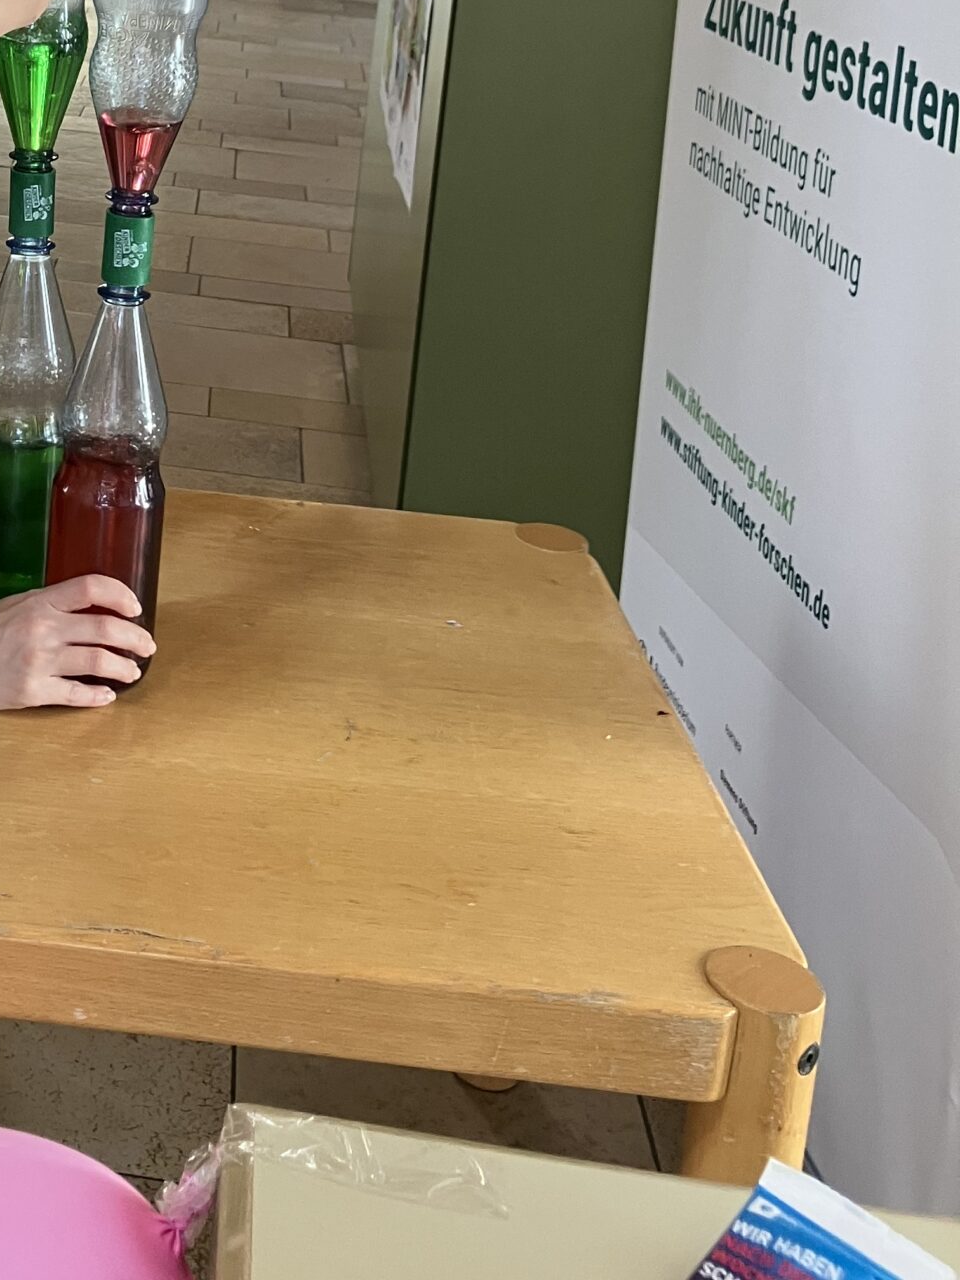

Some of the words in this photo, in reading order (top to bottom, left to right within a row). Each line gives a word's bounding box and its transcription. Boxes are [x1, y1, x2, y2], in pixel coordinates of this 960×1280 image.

[694, 84, 716, 128] mit
[716, 90, 810, 192] MINT-Bildung
[811, 147, 837, 199] für
[801, 30, 959, 155] gestalten
[689, 139, 761, 219] nachhaltige
[763, 185, 863, 298] Entwicklung
[665, 367, 797, 526] www.ihk-nuernberg.de/skf
[660, 415, 830, 630] www.stiftung-kinder-forschen.de
[732, 1220, 774, 1249] WIR
